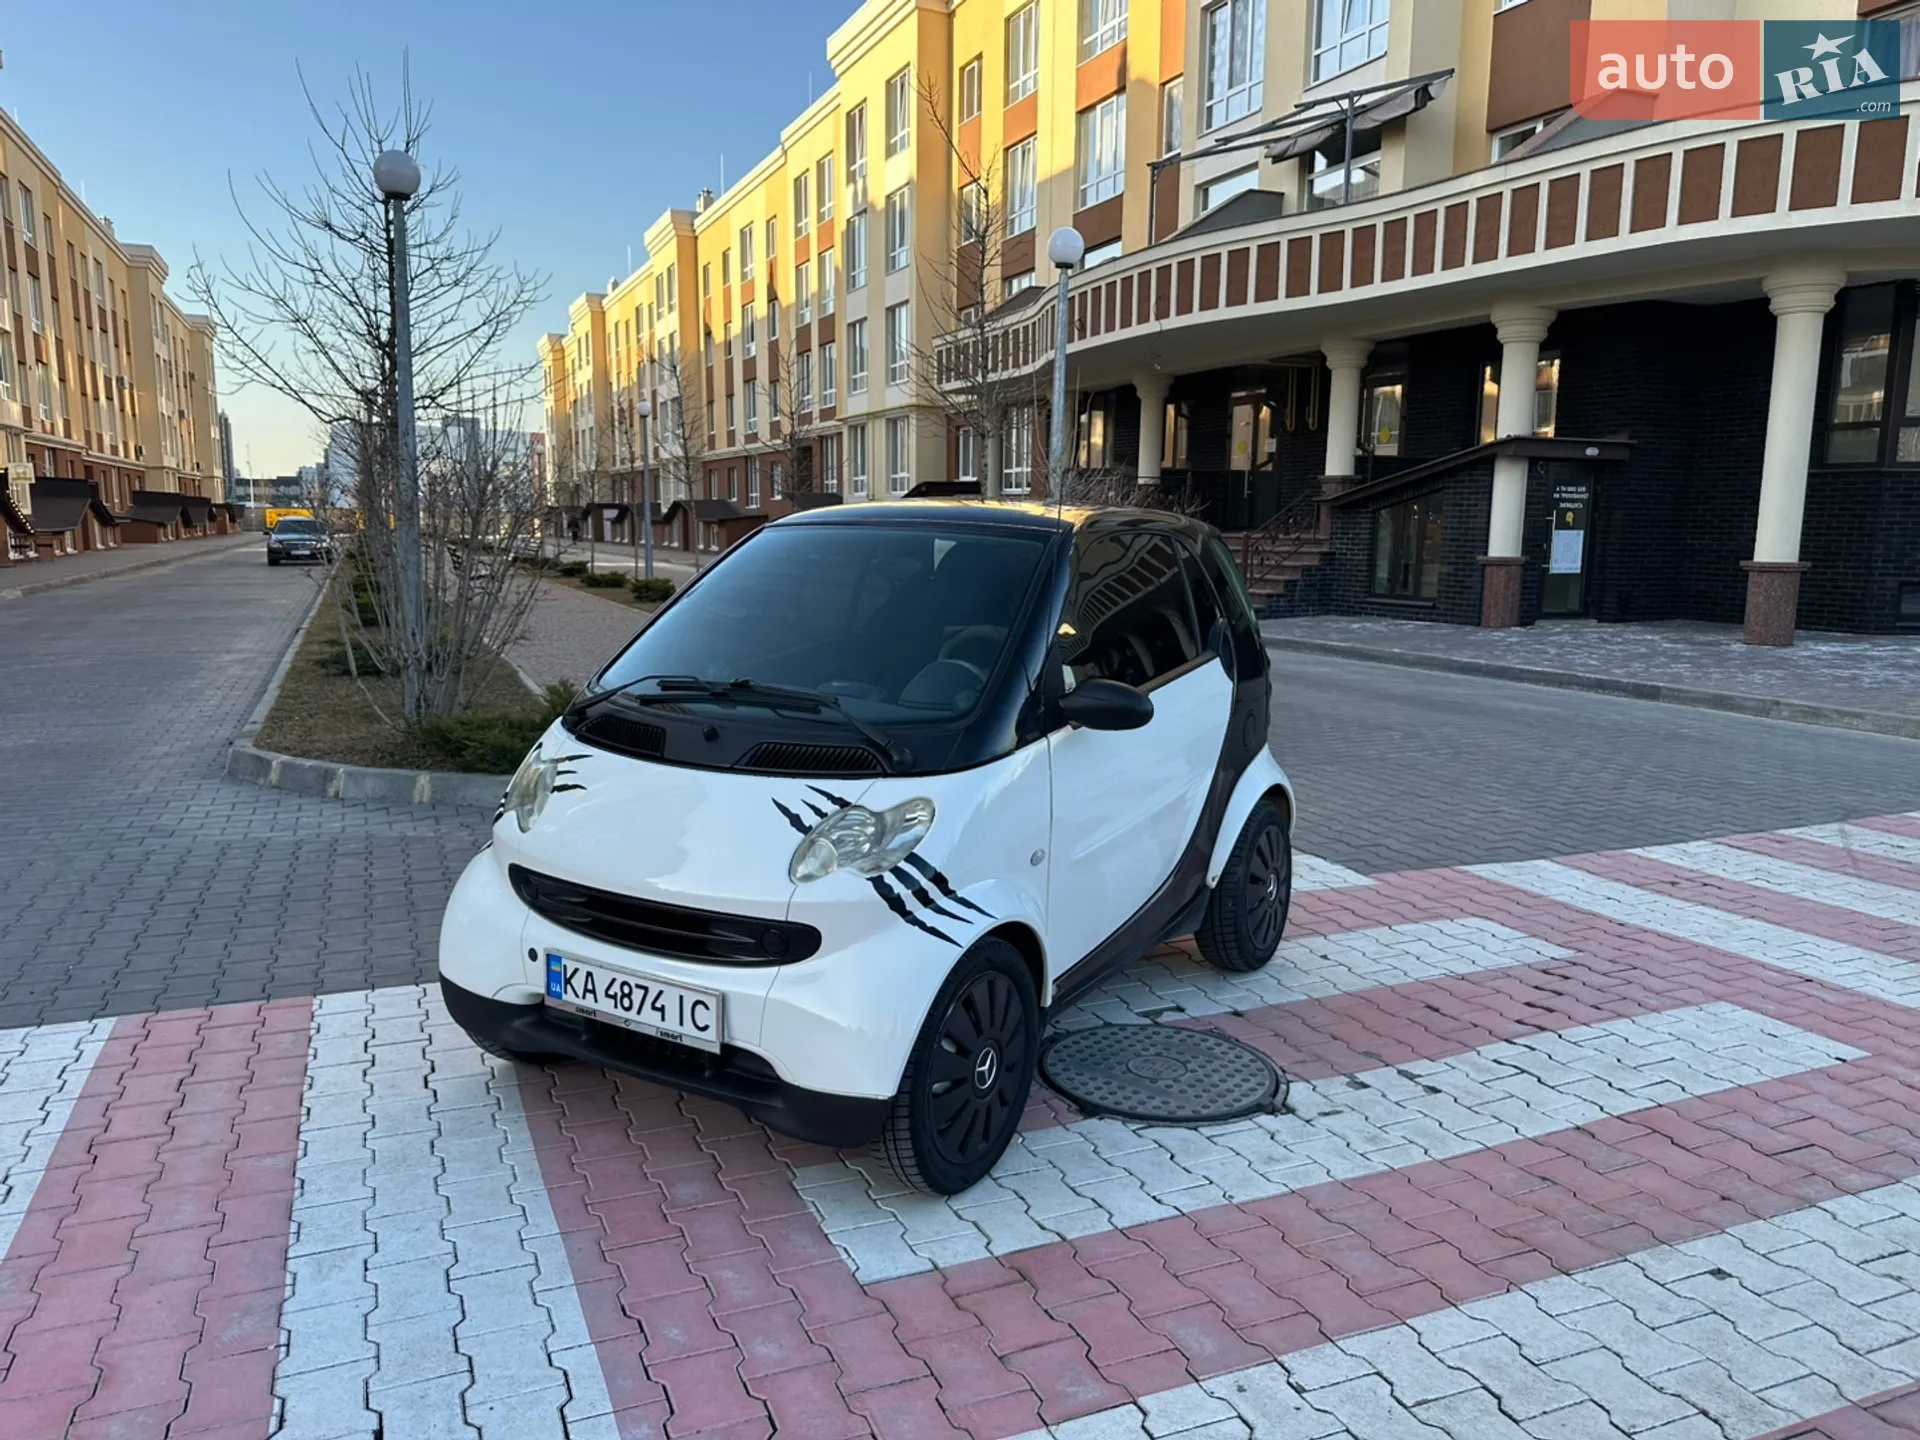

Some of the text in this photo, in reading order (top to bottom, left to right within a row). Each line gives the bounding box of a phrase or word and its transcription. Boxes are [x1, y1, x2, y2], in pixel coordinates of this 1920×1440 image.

[550, 982, 562, 994] UA
[563, 964, 711, 1032] KA 4874 IC
[575, 1006, 598, 1019] smart
[659, 1030, 684, 1042] smart
